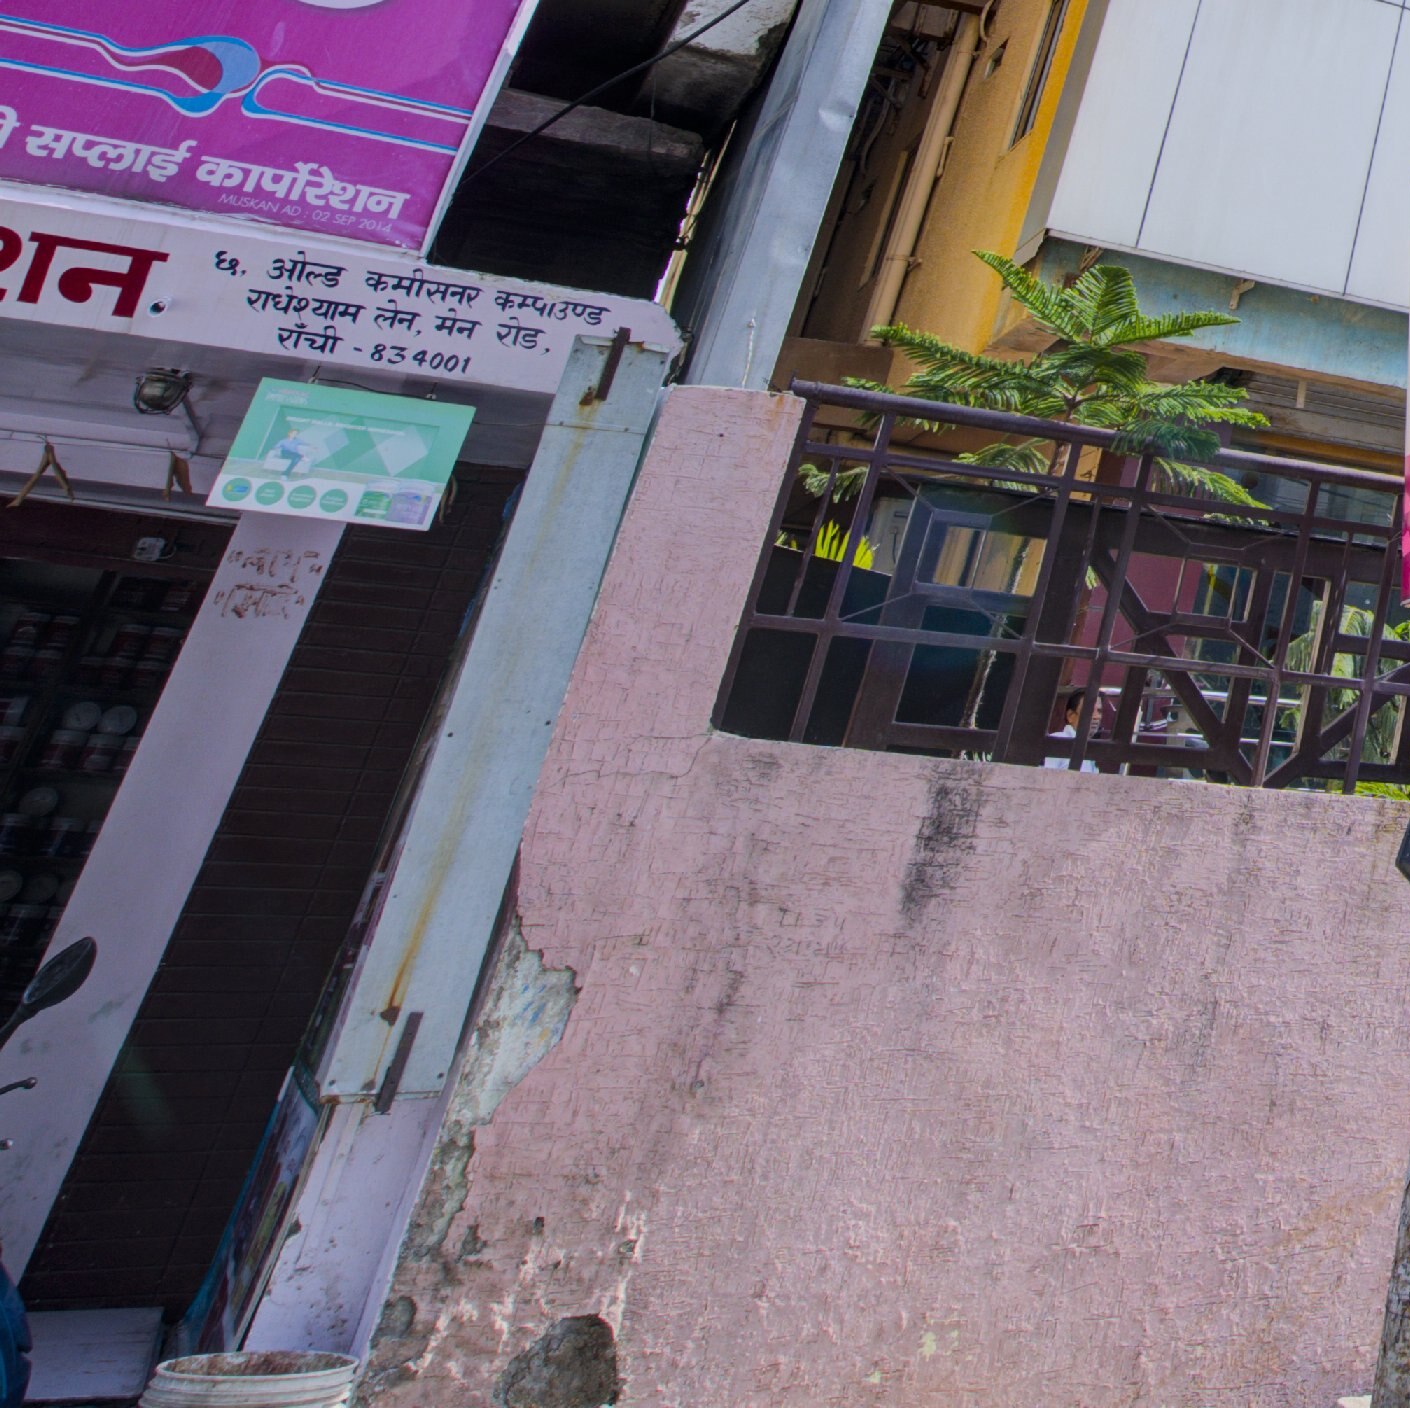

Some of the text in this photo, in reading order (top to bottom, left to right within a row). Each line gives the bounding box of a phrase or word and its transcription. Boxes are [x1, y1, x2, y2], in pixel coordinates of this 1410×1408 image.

[25, 124, 198, 183] सप्लाई
[218, 193, 280, 213] MUSKAN
[434, 307, 483, 341] मेन
